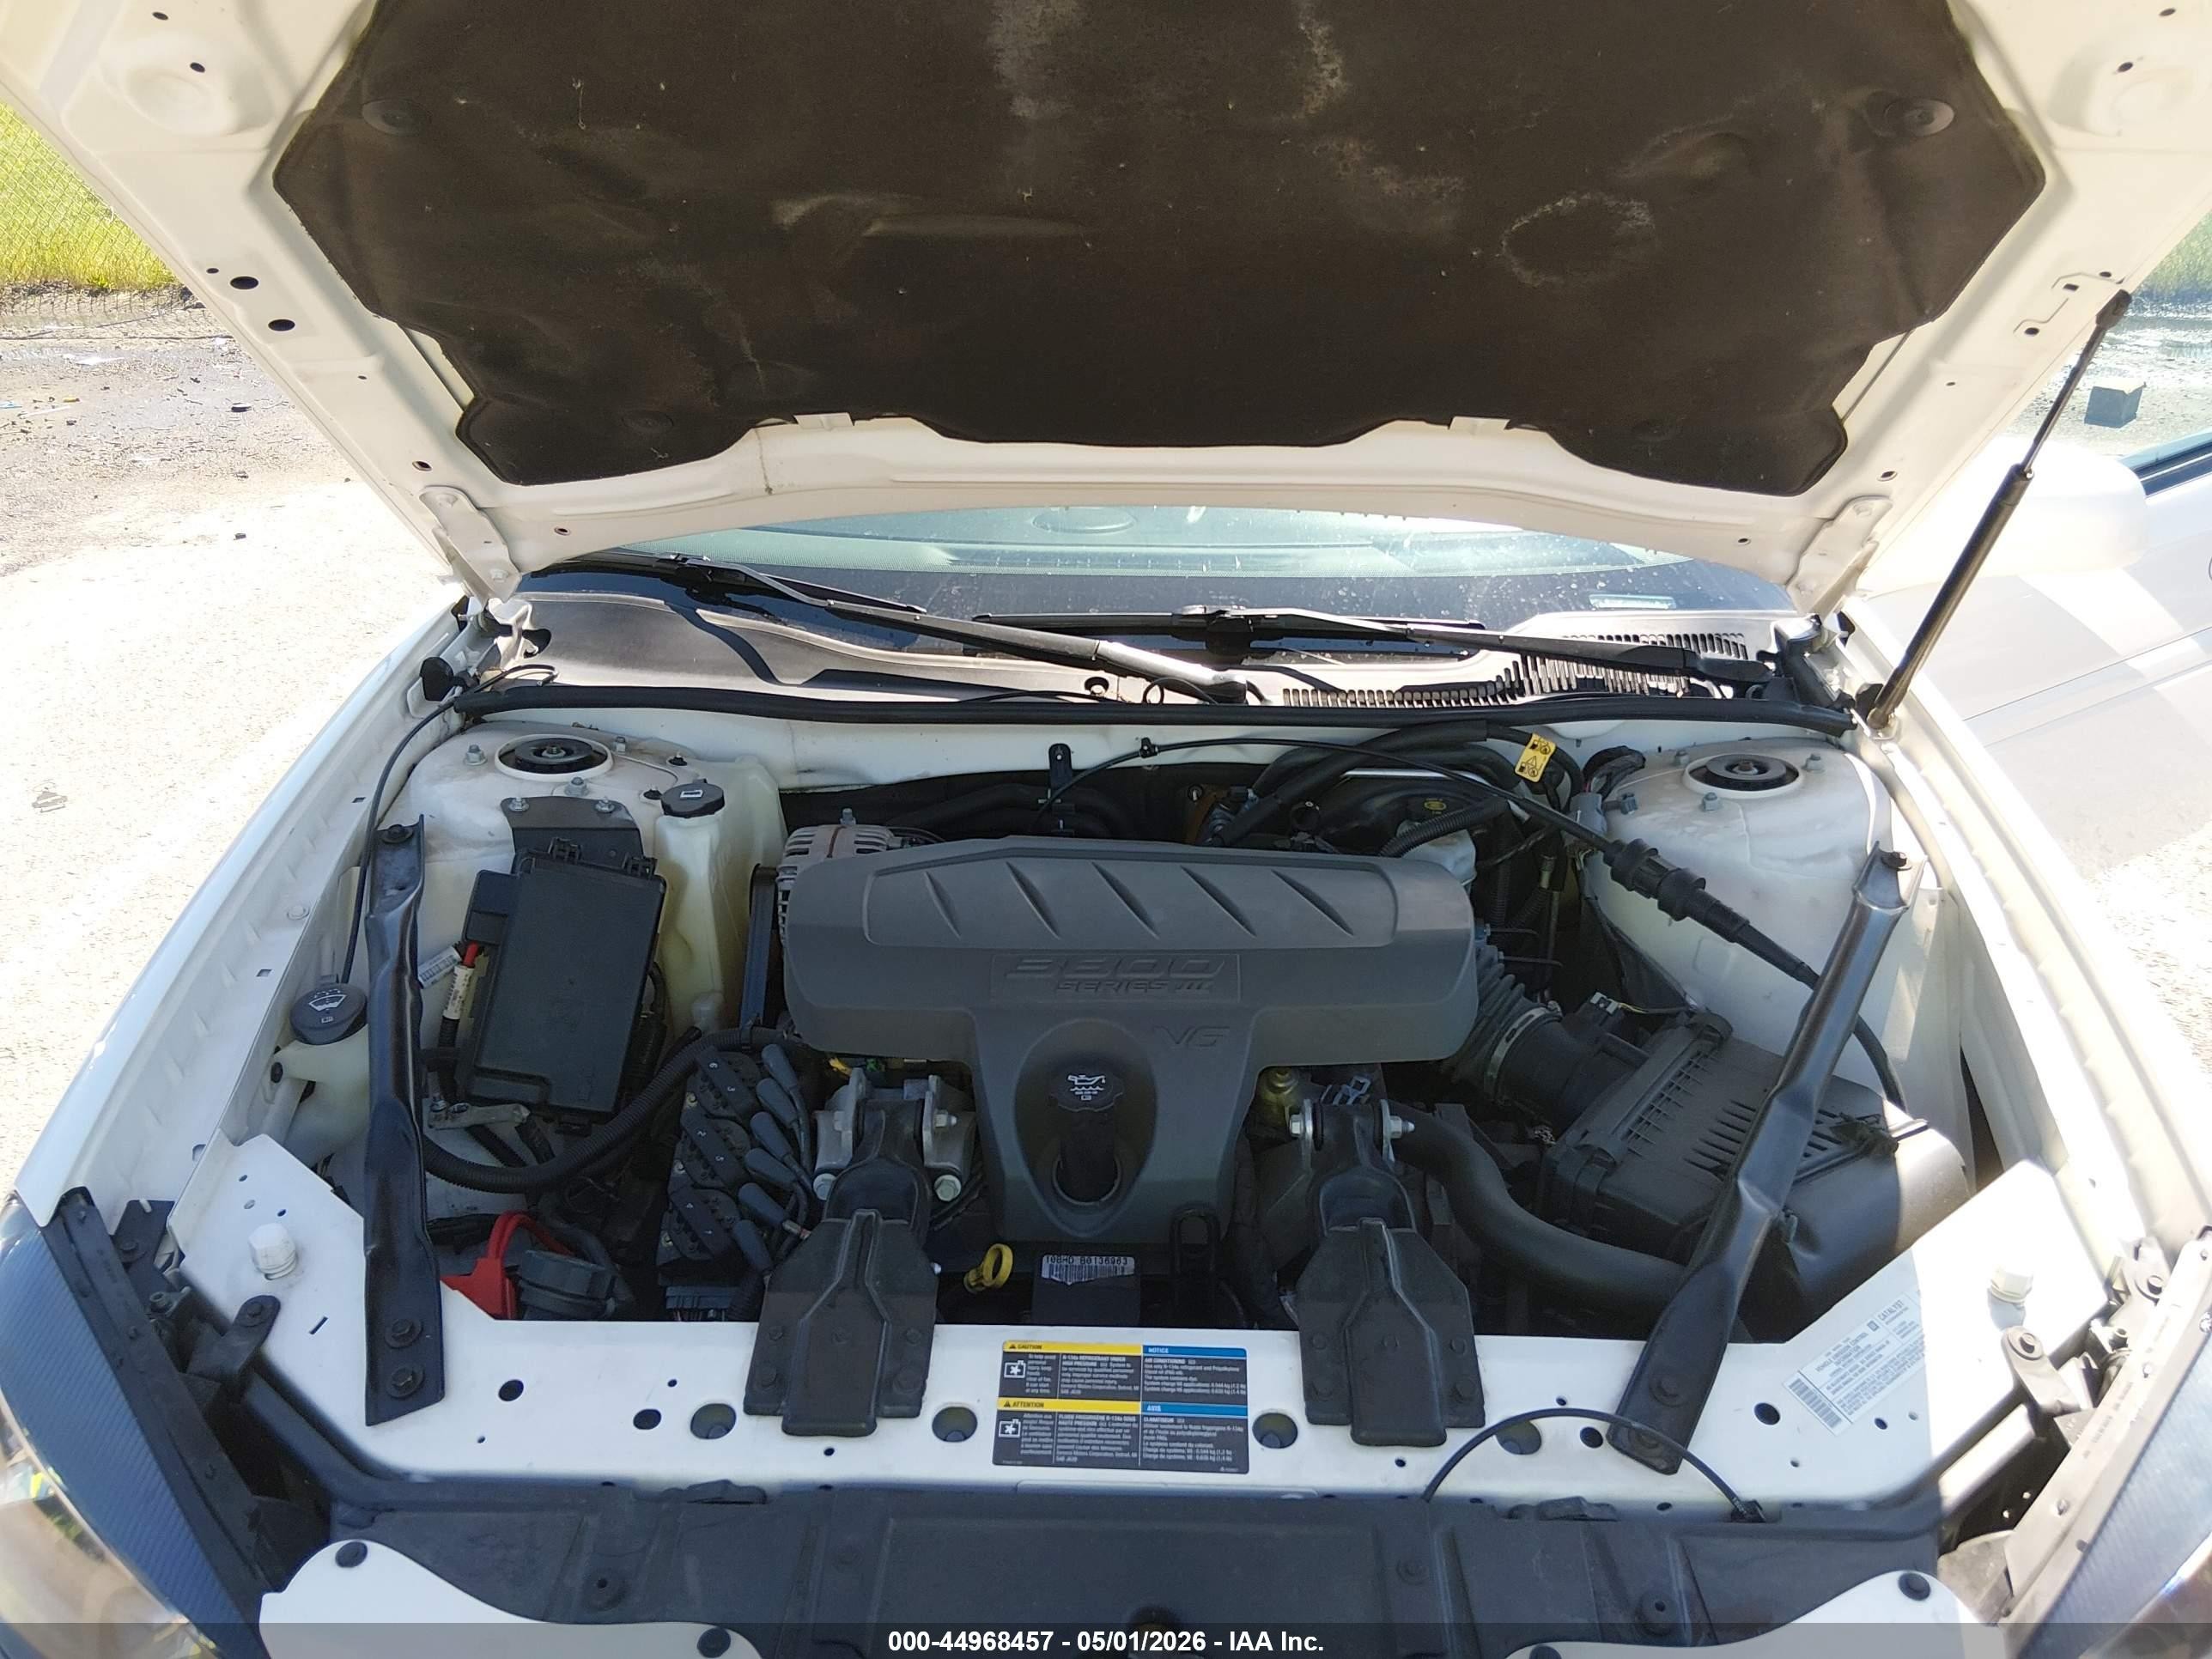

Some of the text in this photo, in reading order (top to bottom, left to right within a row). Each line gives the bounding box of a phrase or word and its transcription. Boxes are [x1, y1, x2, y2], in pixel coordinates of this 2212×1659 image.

[1056, 981, 1215, 994] SERIES III
[1152, 1026, 1230, 1048] V6
[1877, 1298, 1905, 1322] CATALYST
